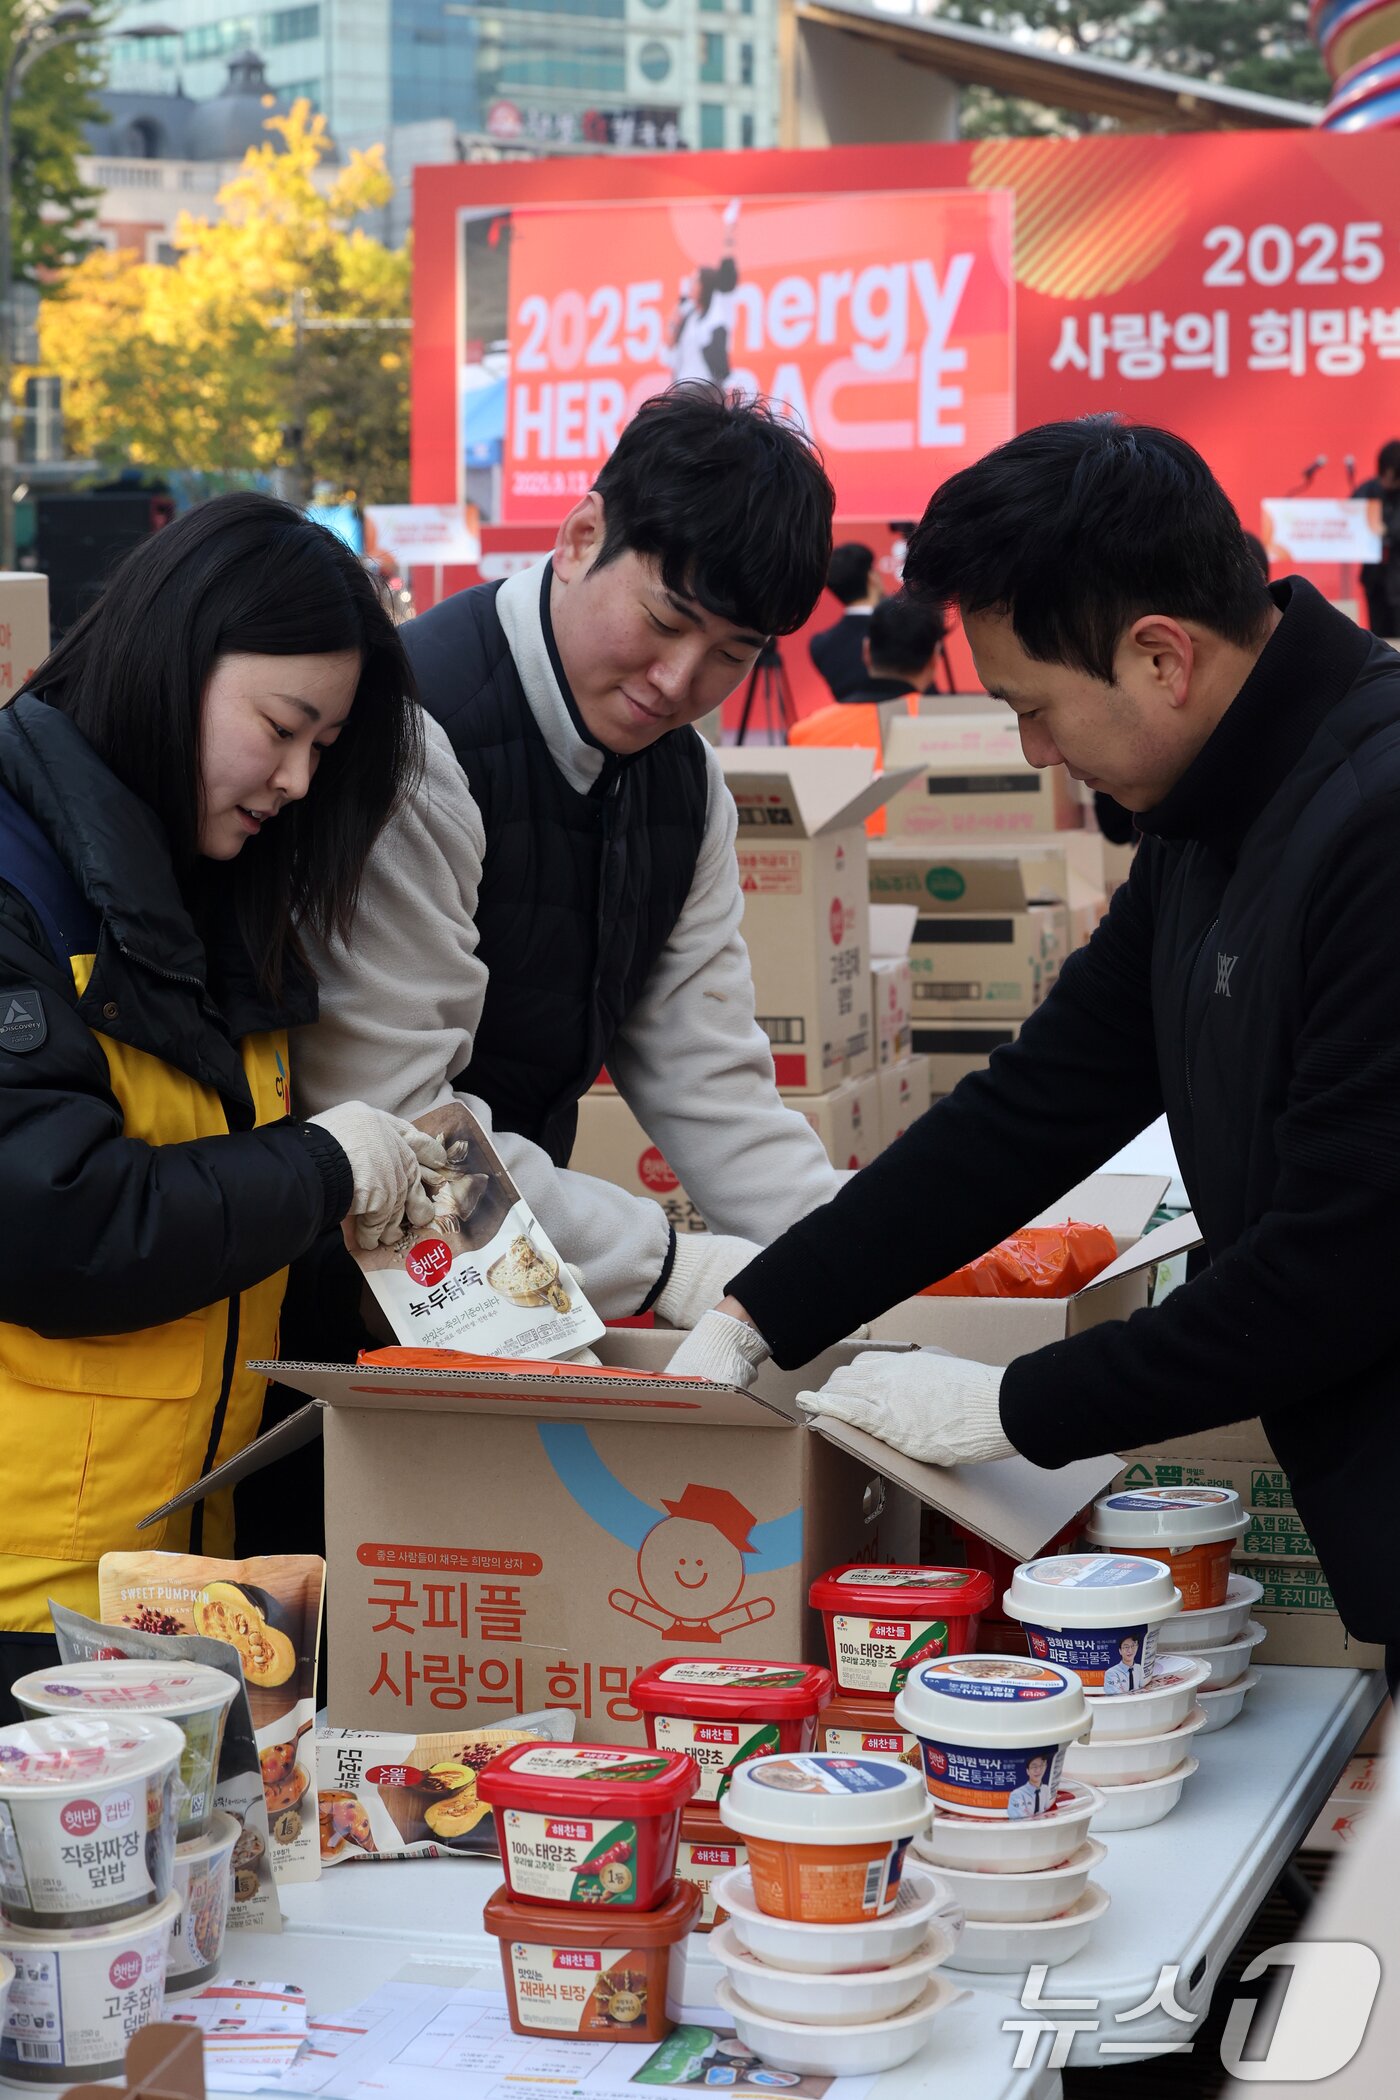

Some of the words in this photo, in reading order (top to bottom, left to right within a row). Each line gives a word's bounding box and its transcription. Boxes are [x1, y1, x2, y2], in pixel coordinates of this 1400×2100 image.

[1203, 222, 1384, 287] 2025
[516, 280, 663, 373] 2025
[680, 254, 975, 372] nergy
[1049, 308, 1230, 380] 사랑의
[410, 1245, 448, 1283] 햇반
[408, 1265, 485, 1318] 녹두닭죽
[421, 1326, 446, 1345] 맛있는
[445, 1314, 461, 1329] 죽의
[461, 1302, 485, 1320] 기준이
[484, 1295, 501, 1310] 되다
[1124, 1463, 1183, 1488] 스팸
[1186, 1468, 1206, 1476] 마일드
[1271, 1474, 1283, 1488] 캡
[1263, 1516, 1276, 1532] 캡
[1277, 1516, 1301, 1533] 없는
[1247, 1534, 1287, 1554] 충격을
[376, 1549, 396, 1562] 좋은
[398, 1551, 437, 1565] 사람들이
[439, 1553, 470, 1567] 채우는
[471, 1555, 501, 1569] 희망의
[503, 1557, 524, 1570] 상자
[1268, 1568, 1292, 1584] 없는
[120, 1586, 155, 1602] SWEET
[157, 1586, 210, 1604] PUMPKIN
[1280, 1588, 1306, 1606] 주지
[164, 1606, 191, 1614] BEANS
[367, 1578, 528, 1643] 굿피플
[875, 1626, 906, 1638] 해찬들
[840, 1643, 860, 1656] 100%
[860, 1643, 897, 1660] 태양초
[1045, 1636, 1074, 1649] 정희원
[1074, 1640, 1096, 1651] 박사
[841, 1655, 859, 1666] 우리쌀
[859, 1657, 878, 1668] 고추장
[1048, 1648, 1111, 1665] 파로통곡물죽
[368, 1650, 524, 1715] 사랑의
[700, 1728, 734, 1742] 해찬들
[867, 1738, 899, 1751] 해찬들
[684, 1747, 725, 1767] 태양초
[928, 1750, 945, 1770] 햇반
[946, 1751, 978, 1768] 정희원
[978, 1756, 1003, 1771] 박사
[378, 1767, 407, 1787] 햇반
[947, 1764, 1018, 1787] 파로통곡물죽
[64, 1807, 98, 1831] 햇반
[105, 1799, 132, 1823] 컵반
[551, 1823, 588, 1839] 해찬들
[60, 1829, 140, 1869] 직화짜장
[511, 1840, 535, 1857] 100%
[535, 1841, 578, 1864] 태양초
[697, 1850, 731, 1864] 해찬들
[88, 1860, 127, 1889] 덮밥
[513, 1856, 534, 1871] 우리쌀
[534, 1858, 556, 1873] 고추장
[113, 1959, 139, 1983] 햇반
[559, 1953, 596, 1969] 해찬들
[518, 1968, 543, 1982] 맛있는
[519, 1981, 558, 2001] 재래식
[559, 1984, 587, 2002] 된장
